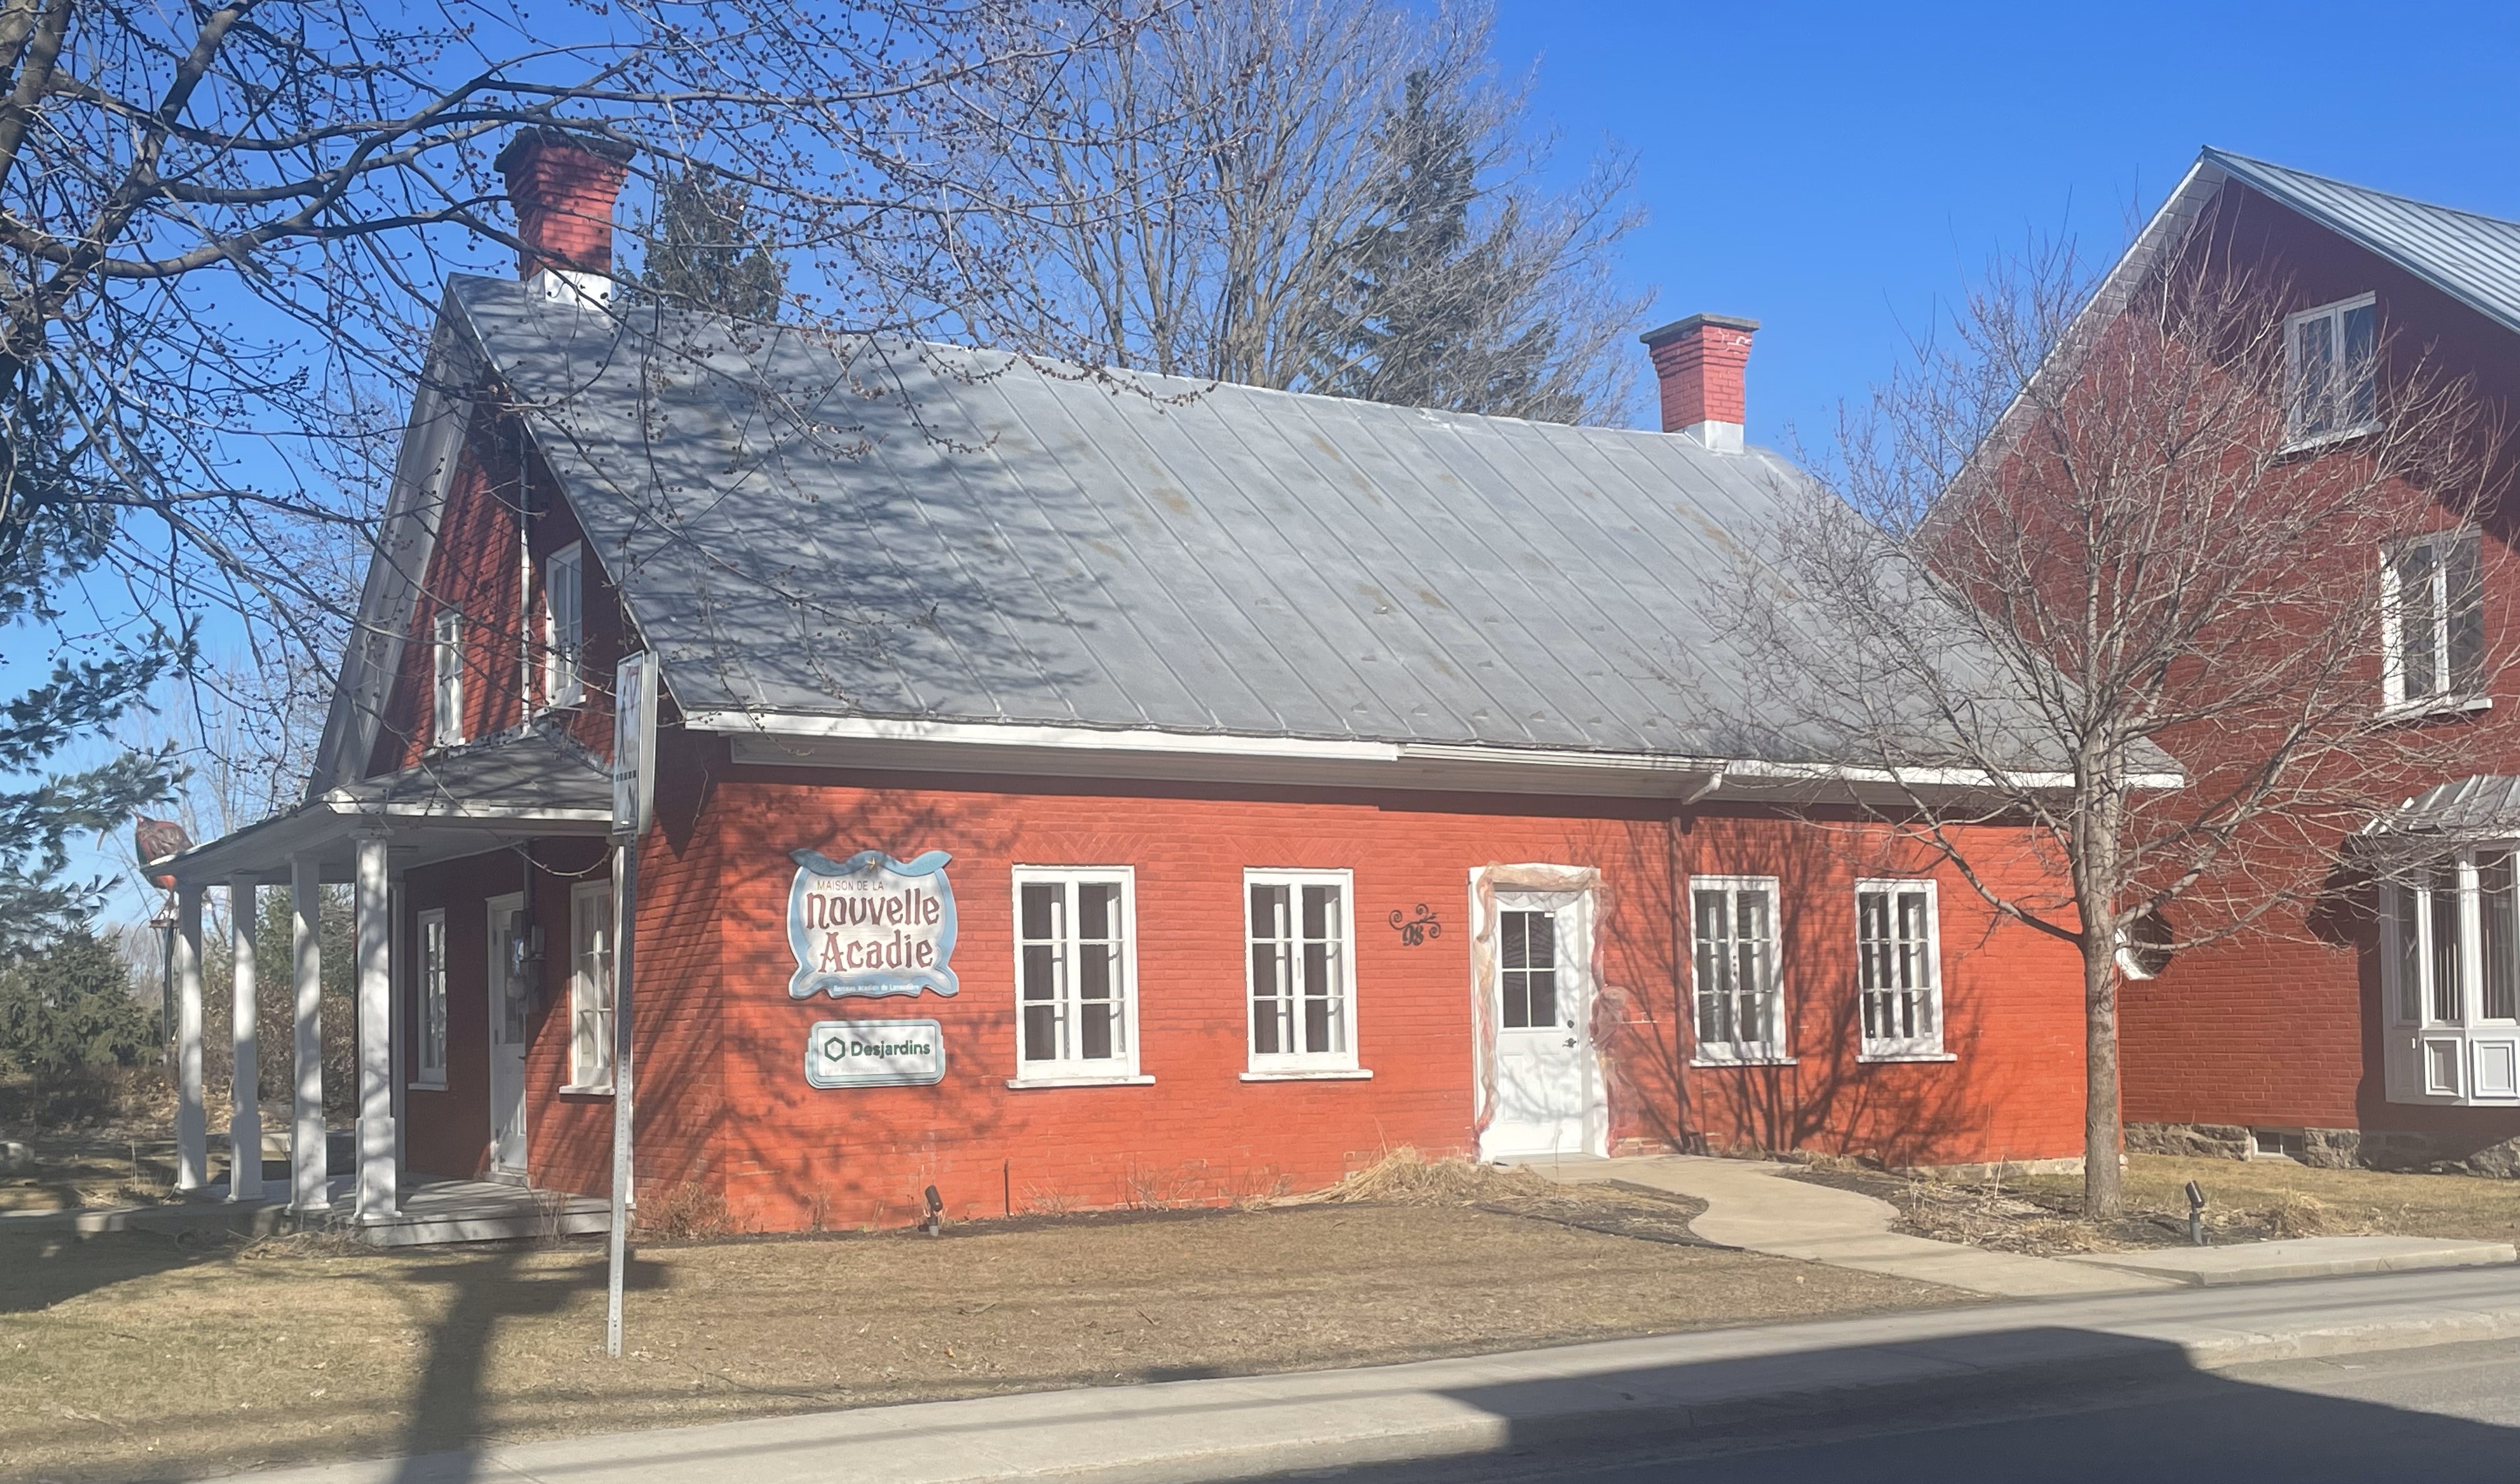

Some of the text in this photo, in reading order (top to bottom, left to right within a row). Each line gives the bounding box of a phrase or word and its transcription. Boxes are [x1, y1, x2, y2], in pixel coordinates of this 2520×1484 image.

[817, 880, 884, 891] MAISON DE LA
[818, 929, 933, 973] Acadie
[851, 1040, 931, 1059] Desjardins
